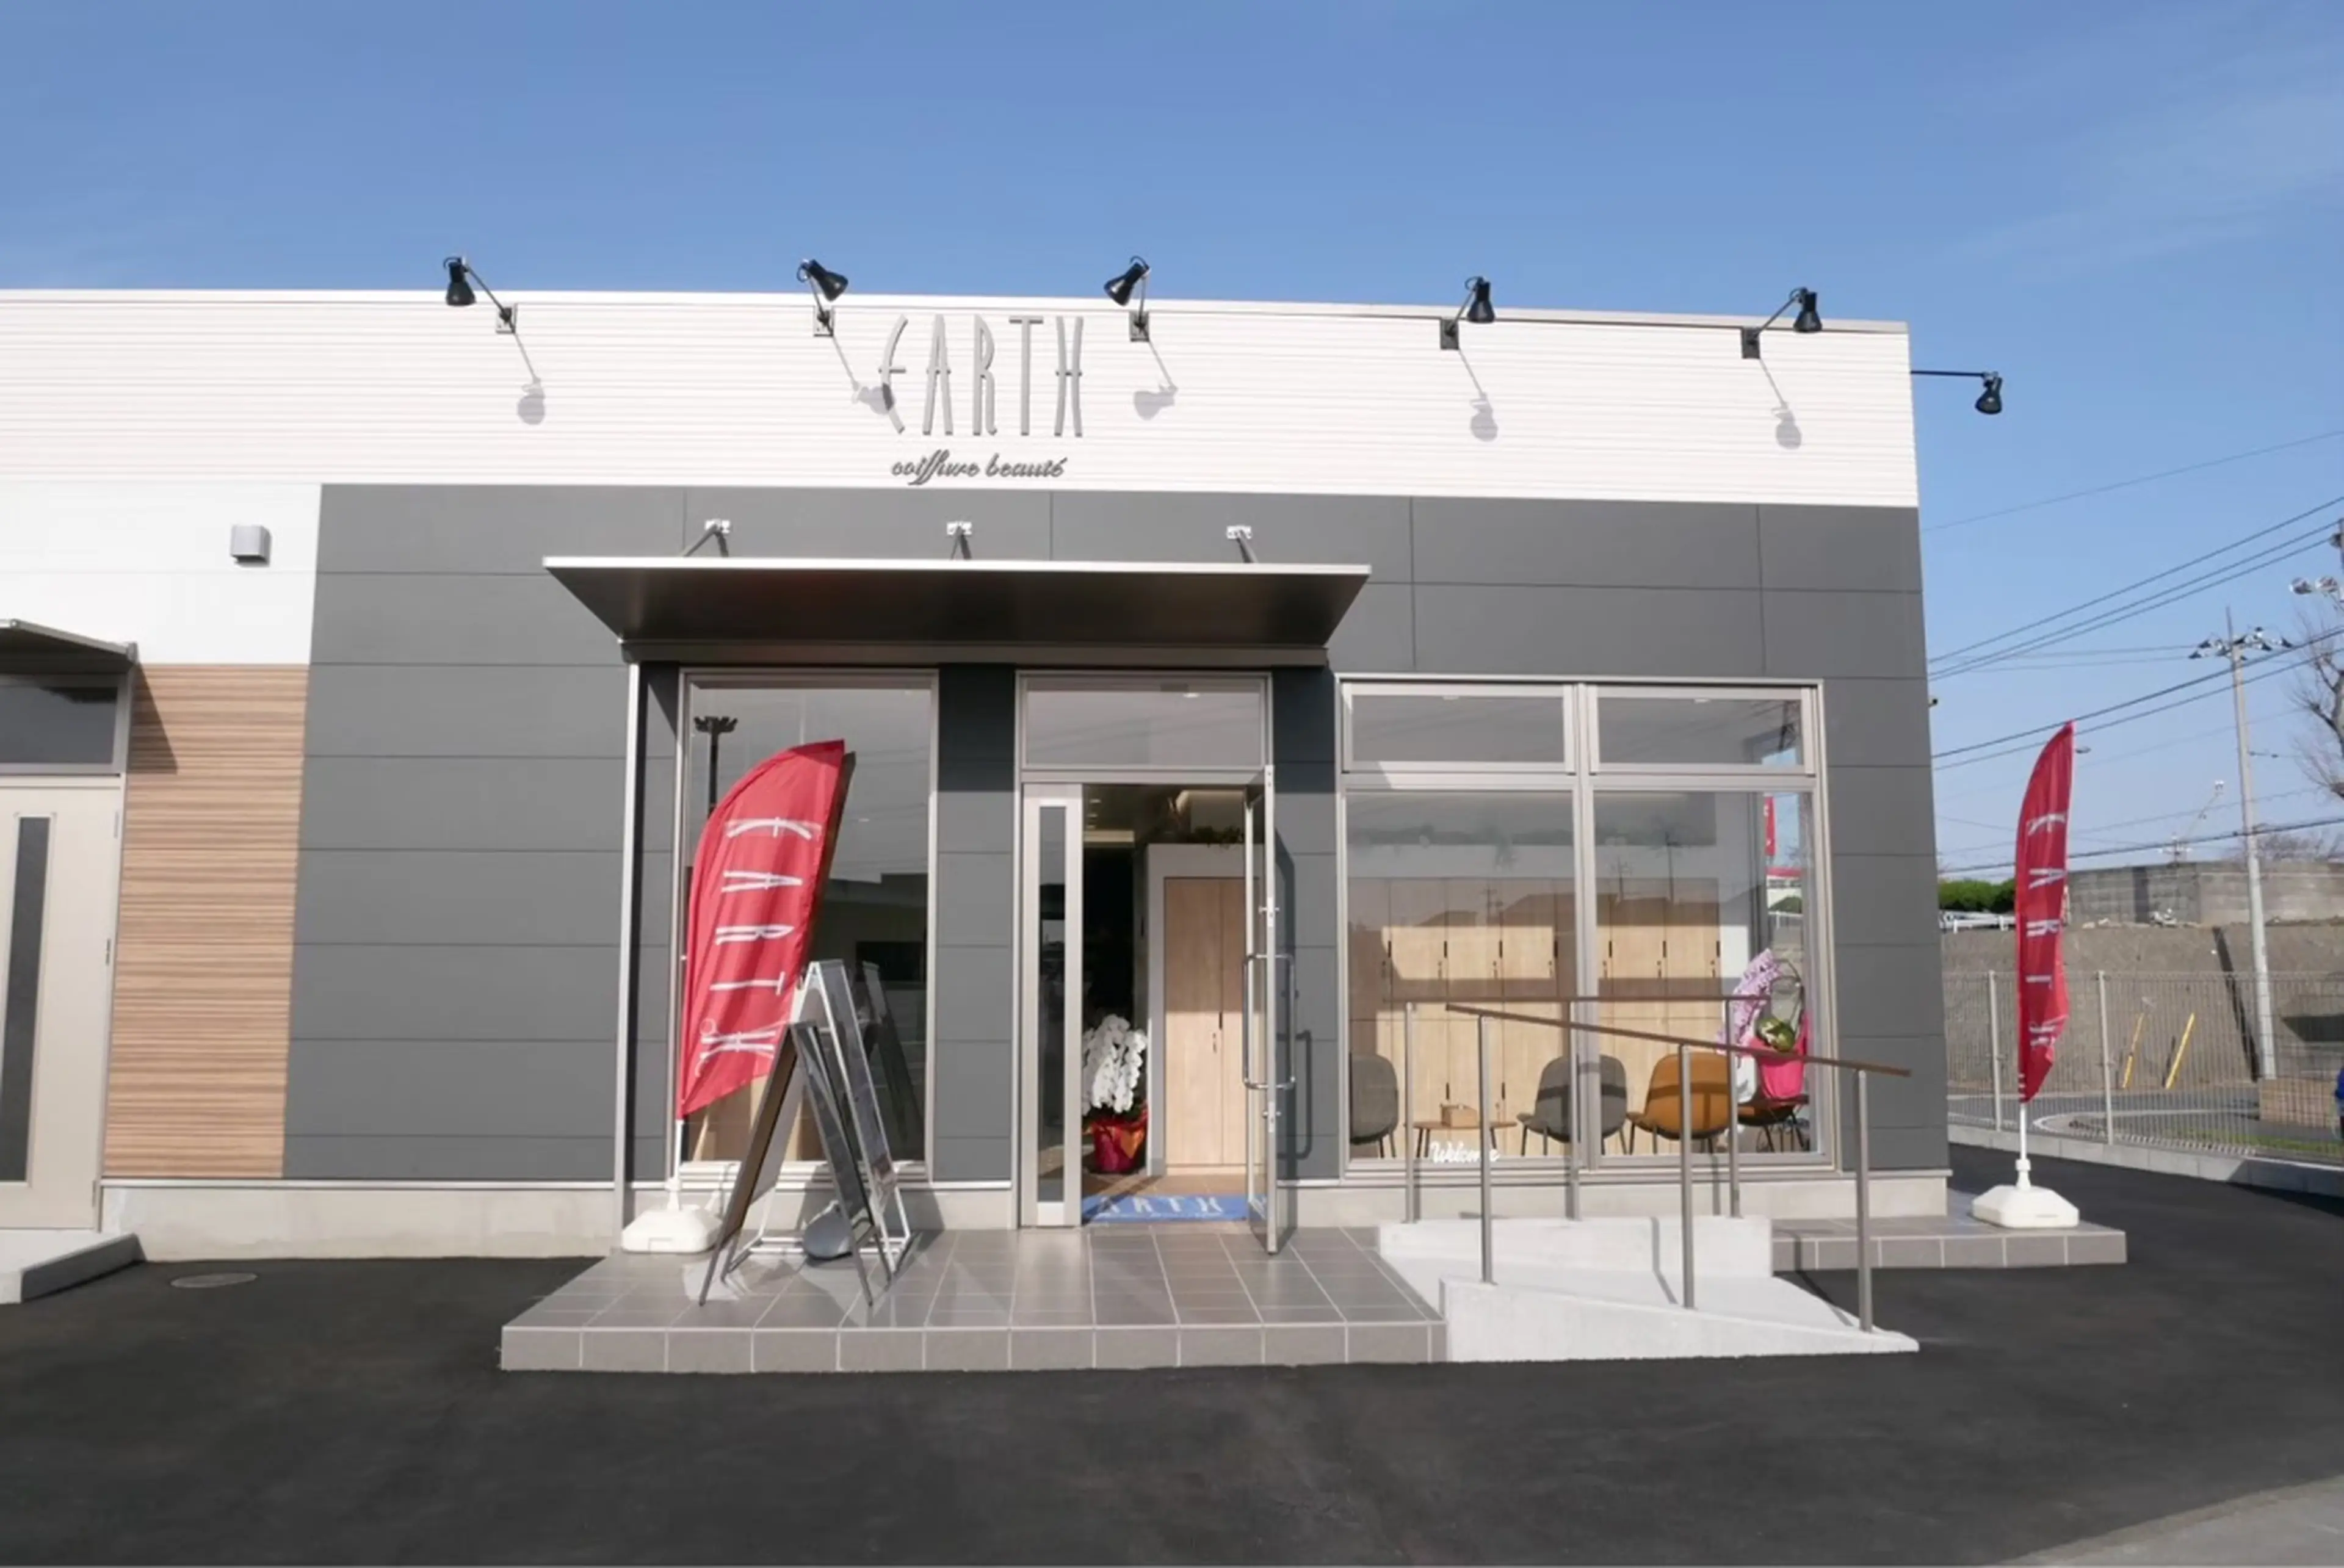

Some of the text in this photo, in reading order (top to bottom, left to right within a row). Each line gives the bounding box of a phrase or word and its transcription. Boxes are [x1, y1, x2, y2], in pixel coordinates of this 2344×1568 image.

[878, 314, 1083, 437] EARTH
[891, 449, 1068, 486] coiffure beauté
[696, 816, 822, 1075] EARTH
